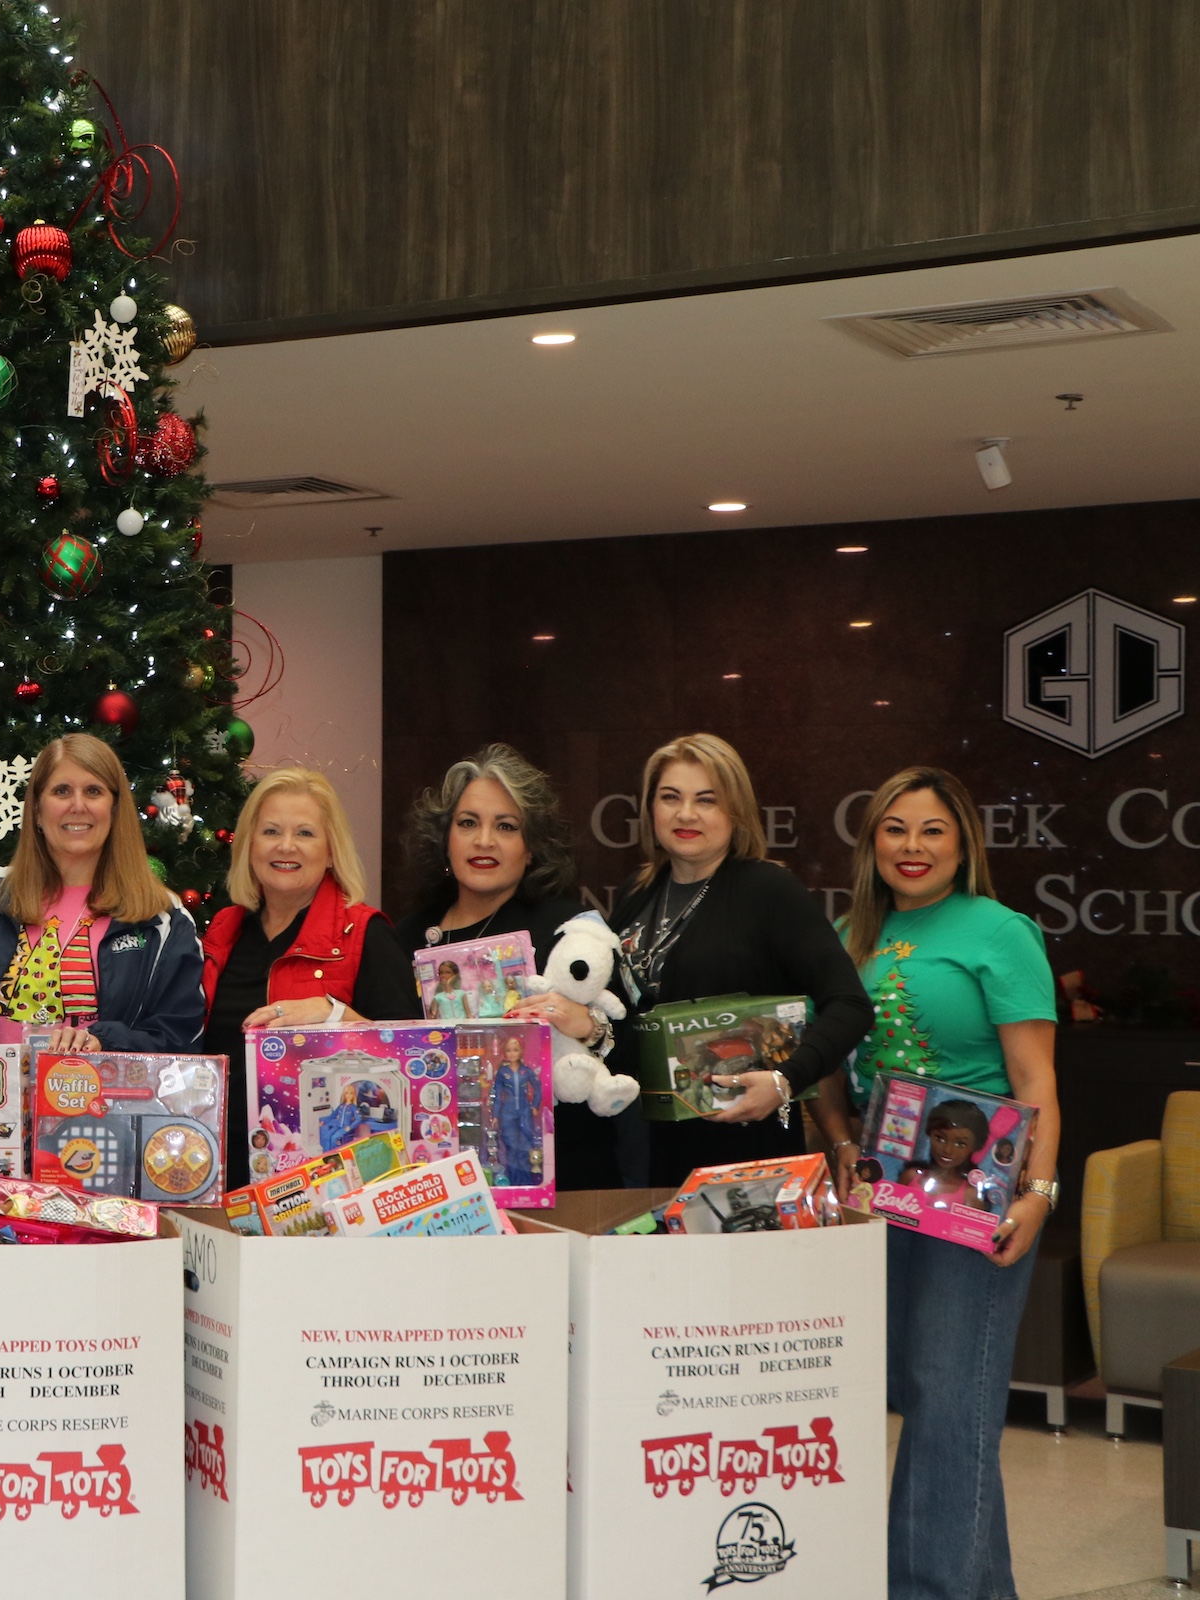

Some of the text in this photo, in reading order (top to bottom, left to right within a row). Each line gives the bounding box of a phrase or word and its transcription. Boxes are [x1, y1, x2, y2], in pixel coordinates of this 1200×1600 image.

[632, 1022, 661, 1032] HALO
[668, 1012, 739, 1034] HALO
[48, 1079, 98, 1094] Waffle
[57, 1094, 86, 1108] Set
[268, 1179, 302, 1197] MATCHBOX
[376, 1176, 441, 1208] BLOCK WORLD
[872, 1183, 923, 1215] Barbie
[273, 1192, 308, 1213] ACTION
[273, 1200, 312, 1224] DRIVERS
[379, 1194, 426, 1218] STARTER
[427, 1186, 444, 1201] KIT
[874, 1208, 918, 1227] FASHIONISTAS
[200, 1315, 232, 1338] TOYS ONLY
[302, 1326, 526, 1344] NEW, UNWRAPPED TOYS ONLY
[644, 1316, 845, 1340] NEW, UNWRAPPED TOYS ONLY
[55, 1340, 97, 1353] TOYS
[101, 1336, 141, 1352] ONLY
[201, 1338, 229, 1364] OCTOBER
[652, 1336, 843, 1360] CAMPAIGN RUNS 1 OCTOBER
[0, 1366, 42, 1379] RUNS
[47, 1367, 53, 1379] 1
[58, 1364, 134, 1378] OCTOBER
[192, 1355, 223, 1380] DECEMBER
[306, 1352, 519, 1369] CAMPAIGN RUNS 1 OCTOBER
[666, 1355, 832, 1377] THROUGH DECEMBER
[30, 1384, 120, 1398] DECEMBER
[321, 1372, 506, 1388] THROUGH DECEMBER
[201, 1390, 226, 1414] RESERVE
[682, 1387, 839, 1409] MARINE CORPS RESERVE
[338, 1404, 514, 1420] MARINE CORPS RESERVE
[7, 1419, 57, 1432] CORPS
[62, 1417, 128, 1430] RESERVE
[200, 1442, 222, 1483] TOTS
[306, 1451, 507, 1486] TOYS FOR TOTS
[648, 1442, 830, 1476] TOYS FOR TOTS
[55, 1471, 122, 1501] TOTS
